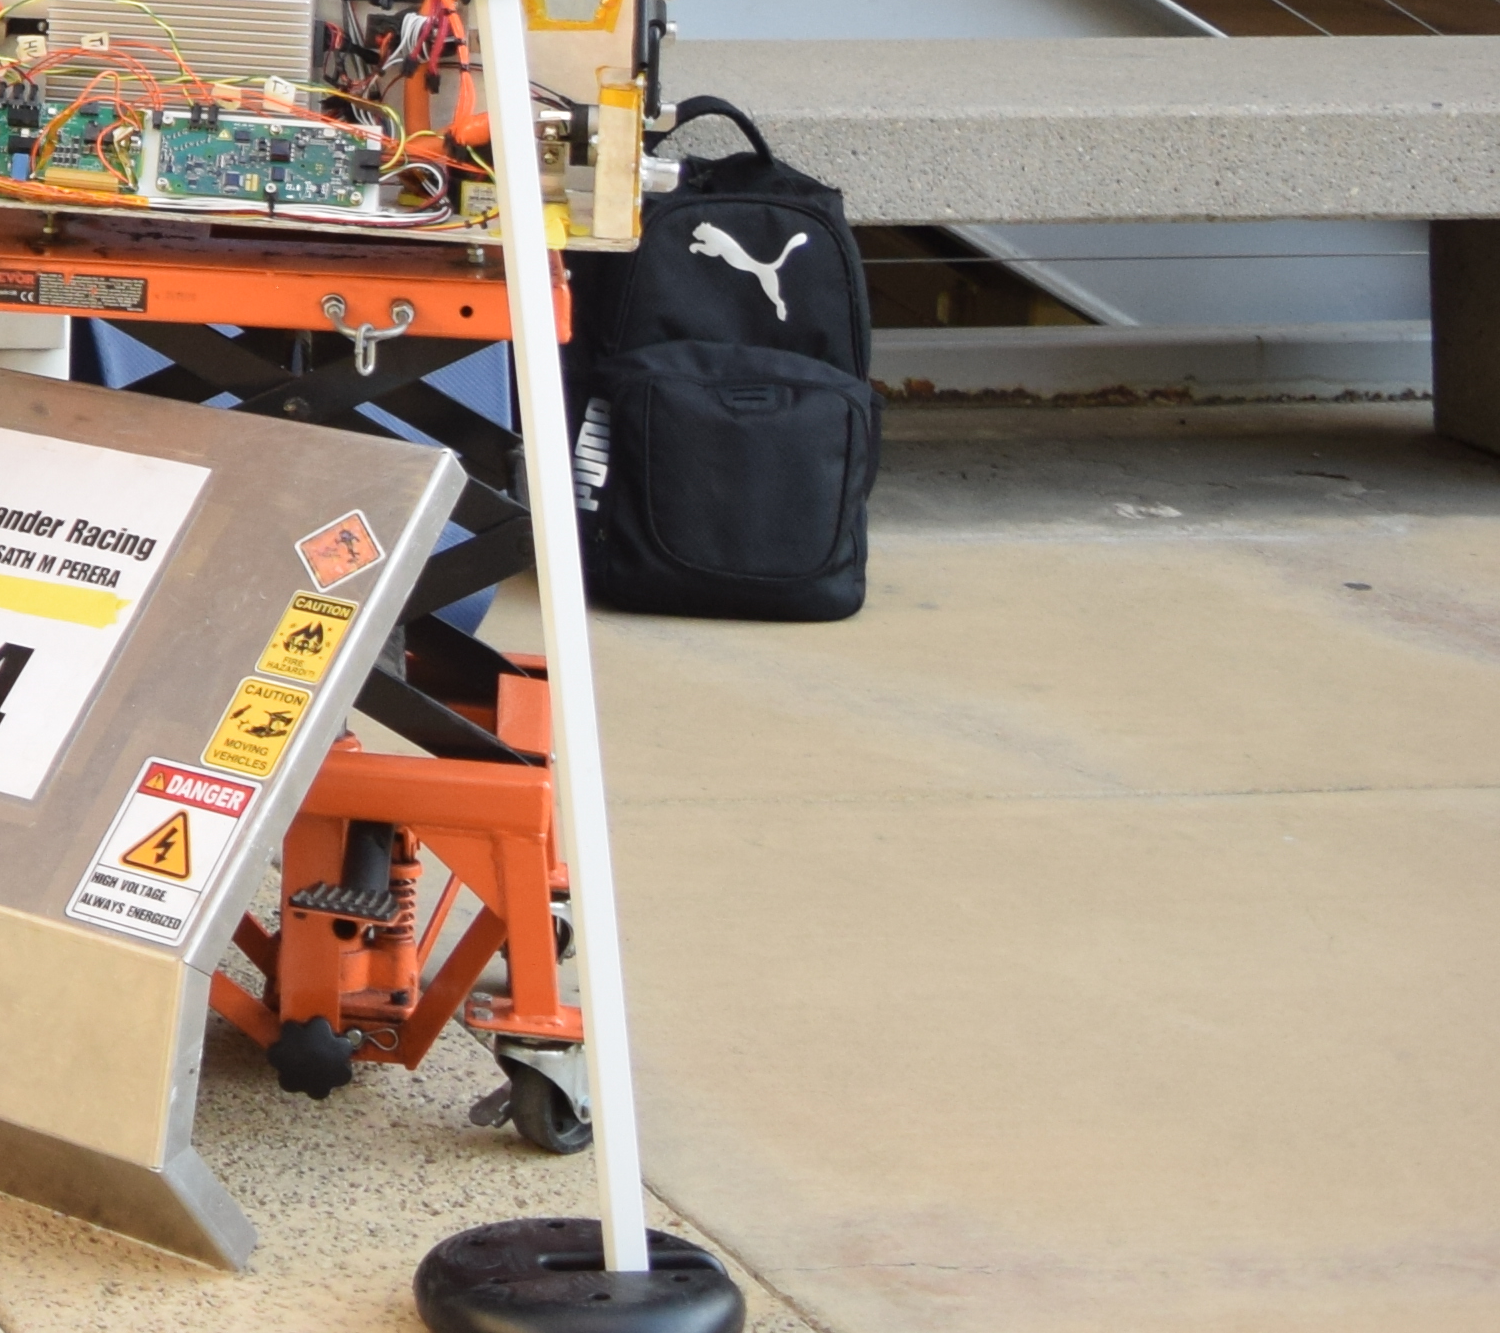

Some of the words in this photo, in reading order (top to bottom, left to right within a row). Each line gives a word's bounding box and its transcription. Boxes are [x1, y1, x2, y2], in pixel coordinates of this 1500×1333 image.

[575, 396, 612, 512] PUMA
[66, 518, 157, 561] Racing
[37, 554, 58, 574] M
[57, 560, 121, 589] PERERA
[294, 597, 351, 619] CAUTION
[283, 655, 305, 667] FIRE
[244, 683, 305, 707] CAUTION
[224, 737, 268, 757] MOVING
[213, 749, 268, 772] VEHICLES
[166, 774, 246, 812] DANGER
[90, 871, 118, 889] HIGH
[80, 892, 126, 915] ALWAYS
[126, 905, 183, 931] ENERGIZED
